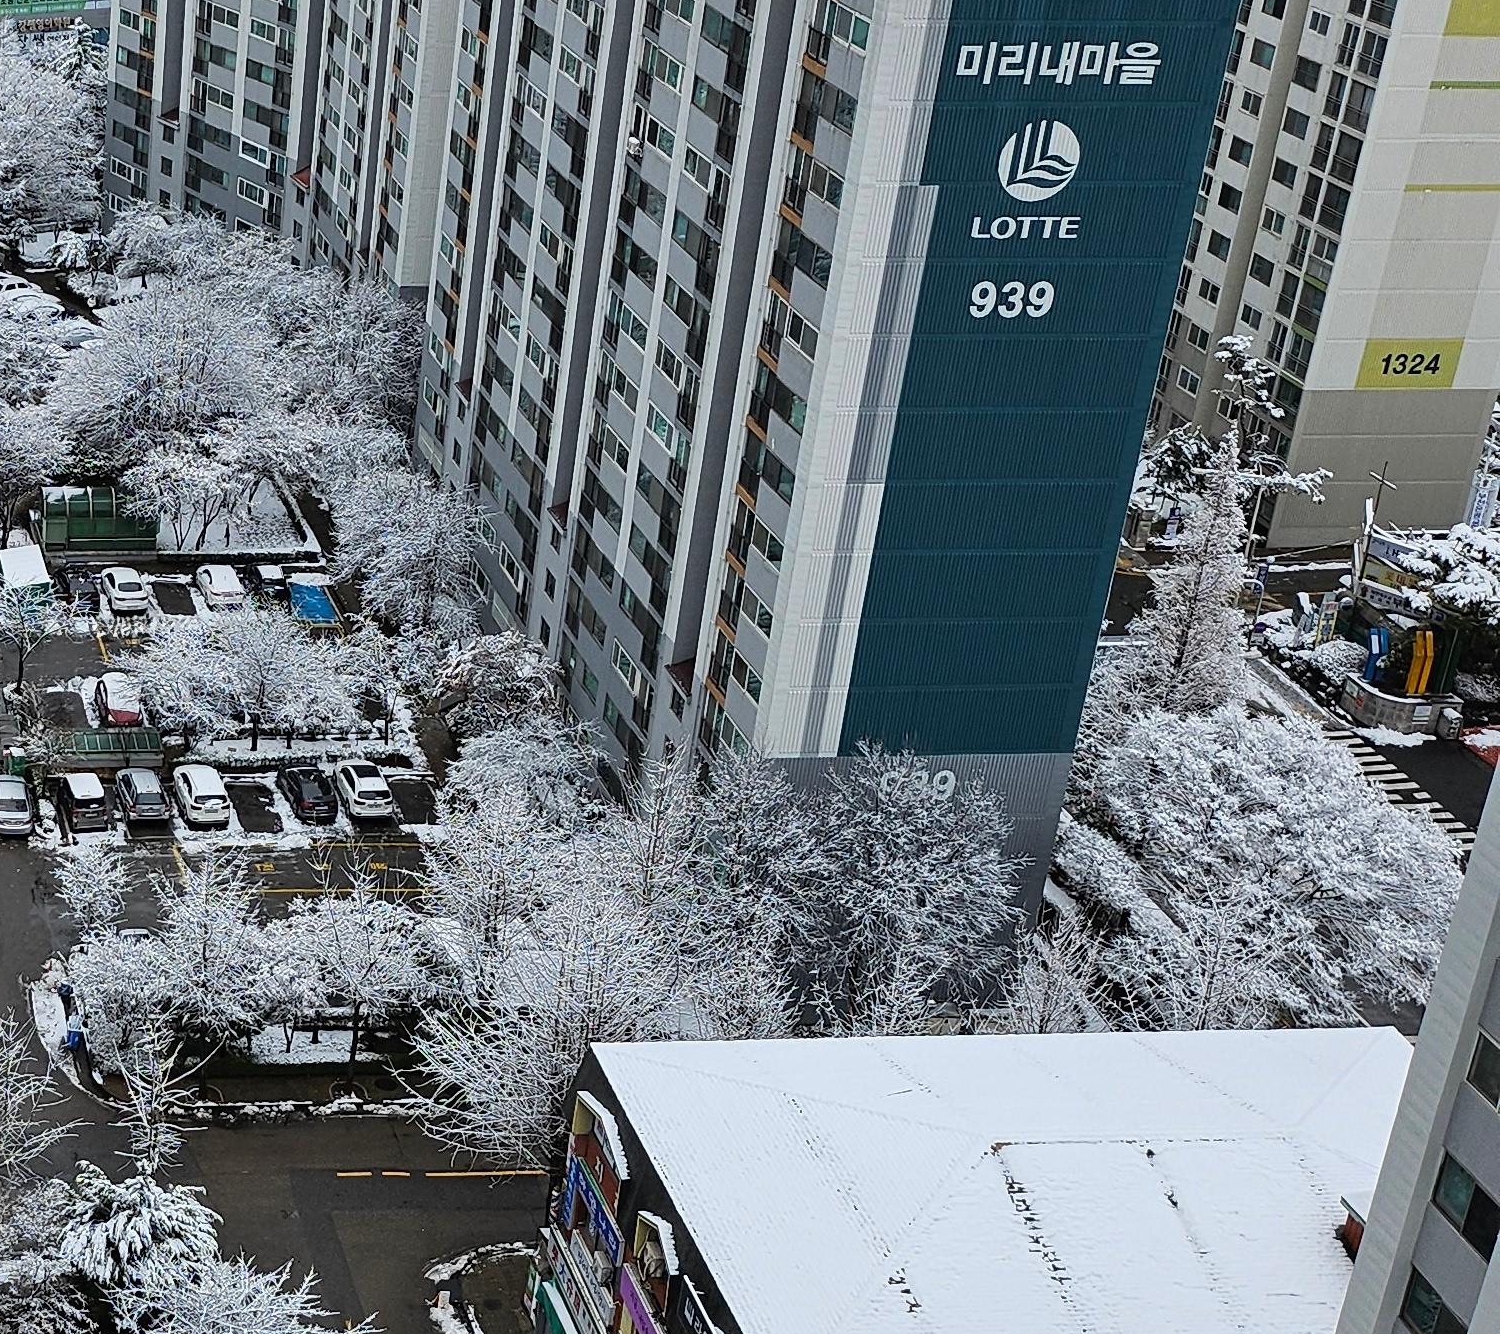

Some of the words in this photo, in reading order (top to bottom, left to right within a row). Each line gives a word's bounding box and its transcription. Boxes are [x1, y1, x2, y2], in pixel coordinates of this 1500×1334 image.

[955, 41, 1162, 86] 미리내마을
[970, 216, 1081, 240] LOTTE
[969, 280, 1056, 319] 939
[1380, 351, 1442, 377] 1324
